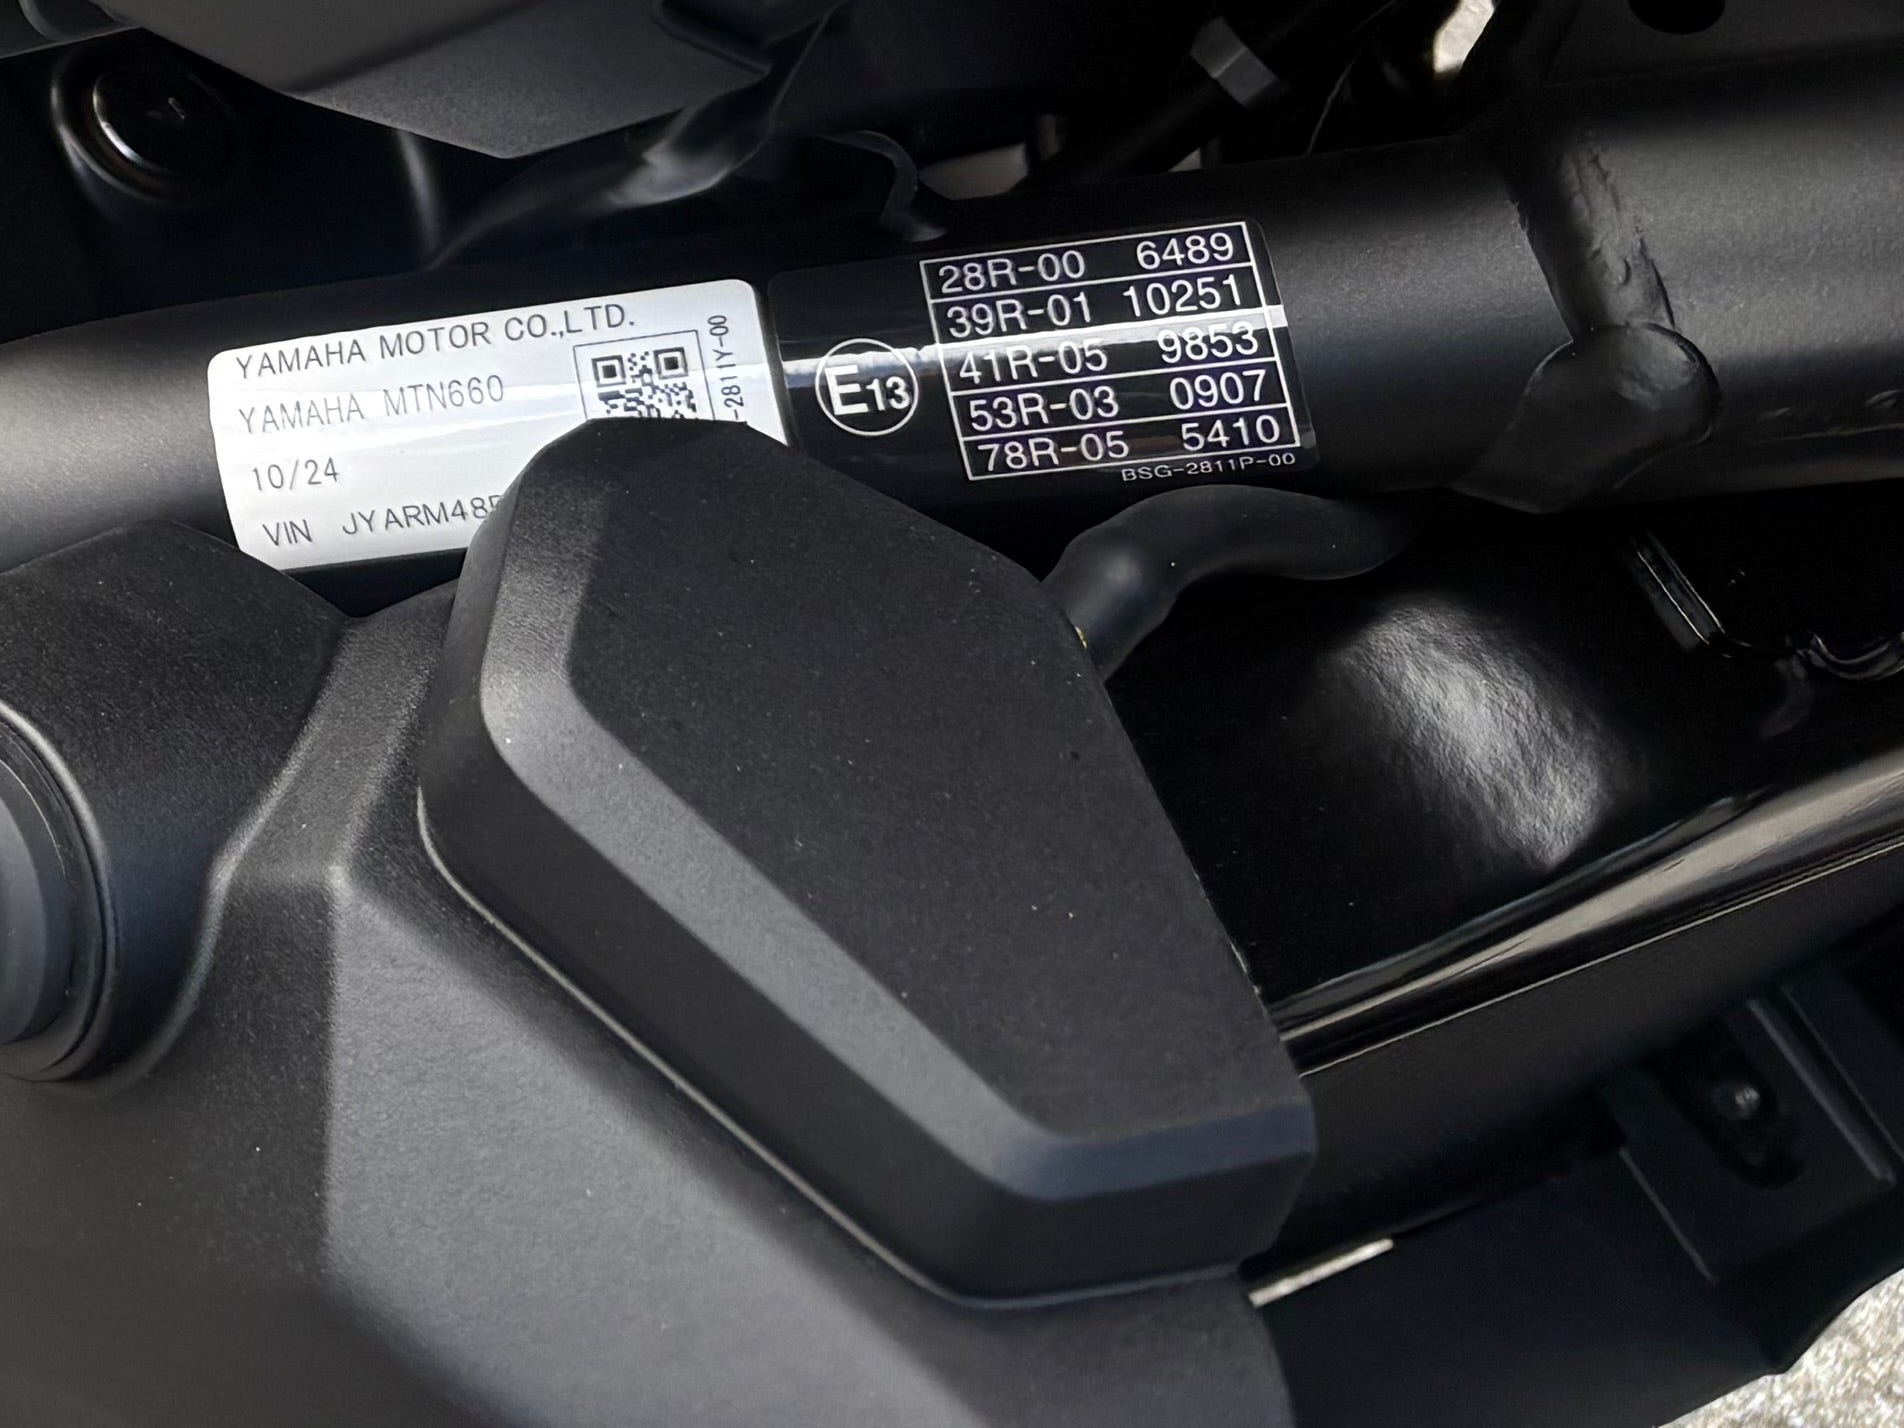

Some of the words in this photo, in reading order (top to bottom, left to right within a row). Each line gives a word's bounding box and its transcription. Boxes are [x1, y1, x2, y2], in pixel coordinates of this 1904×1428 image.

[939, 251, 1086, 295] 28R-00
[1136, 231, 1235, 270] 6489
[946, 292, 1093, 338] 39R-01
[1123, 274, 1241, 317] 10251
[236, 339, 366, 380] YAMAHA
[379, 320, 491, 361] MOTOR
[504, 303, 636, 339] CO.,LTD.
[958, 338, 1108, 385] 41R-05
[1156, 321, 1259, 364] 9853
[239, 393, 365, 435] YAMAHA
[384, 374, 504, 418] MTN660
[968, 385, 1120, 432] 53R-03
[1169, 369, 1266, 411] 0907
[977, 430, 1129, 472] 78R-05
[1181, 414, 1279, 451] 5410
[1121, 451, 1296, 482] BSG-2811P-00
[252, 457, 340, 493] 10/24
[263, 518, 312, 548] VIN
